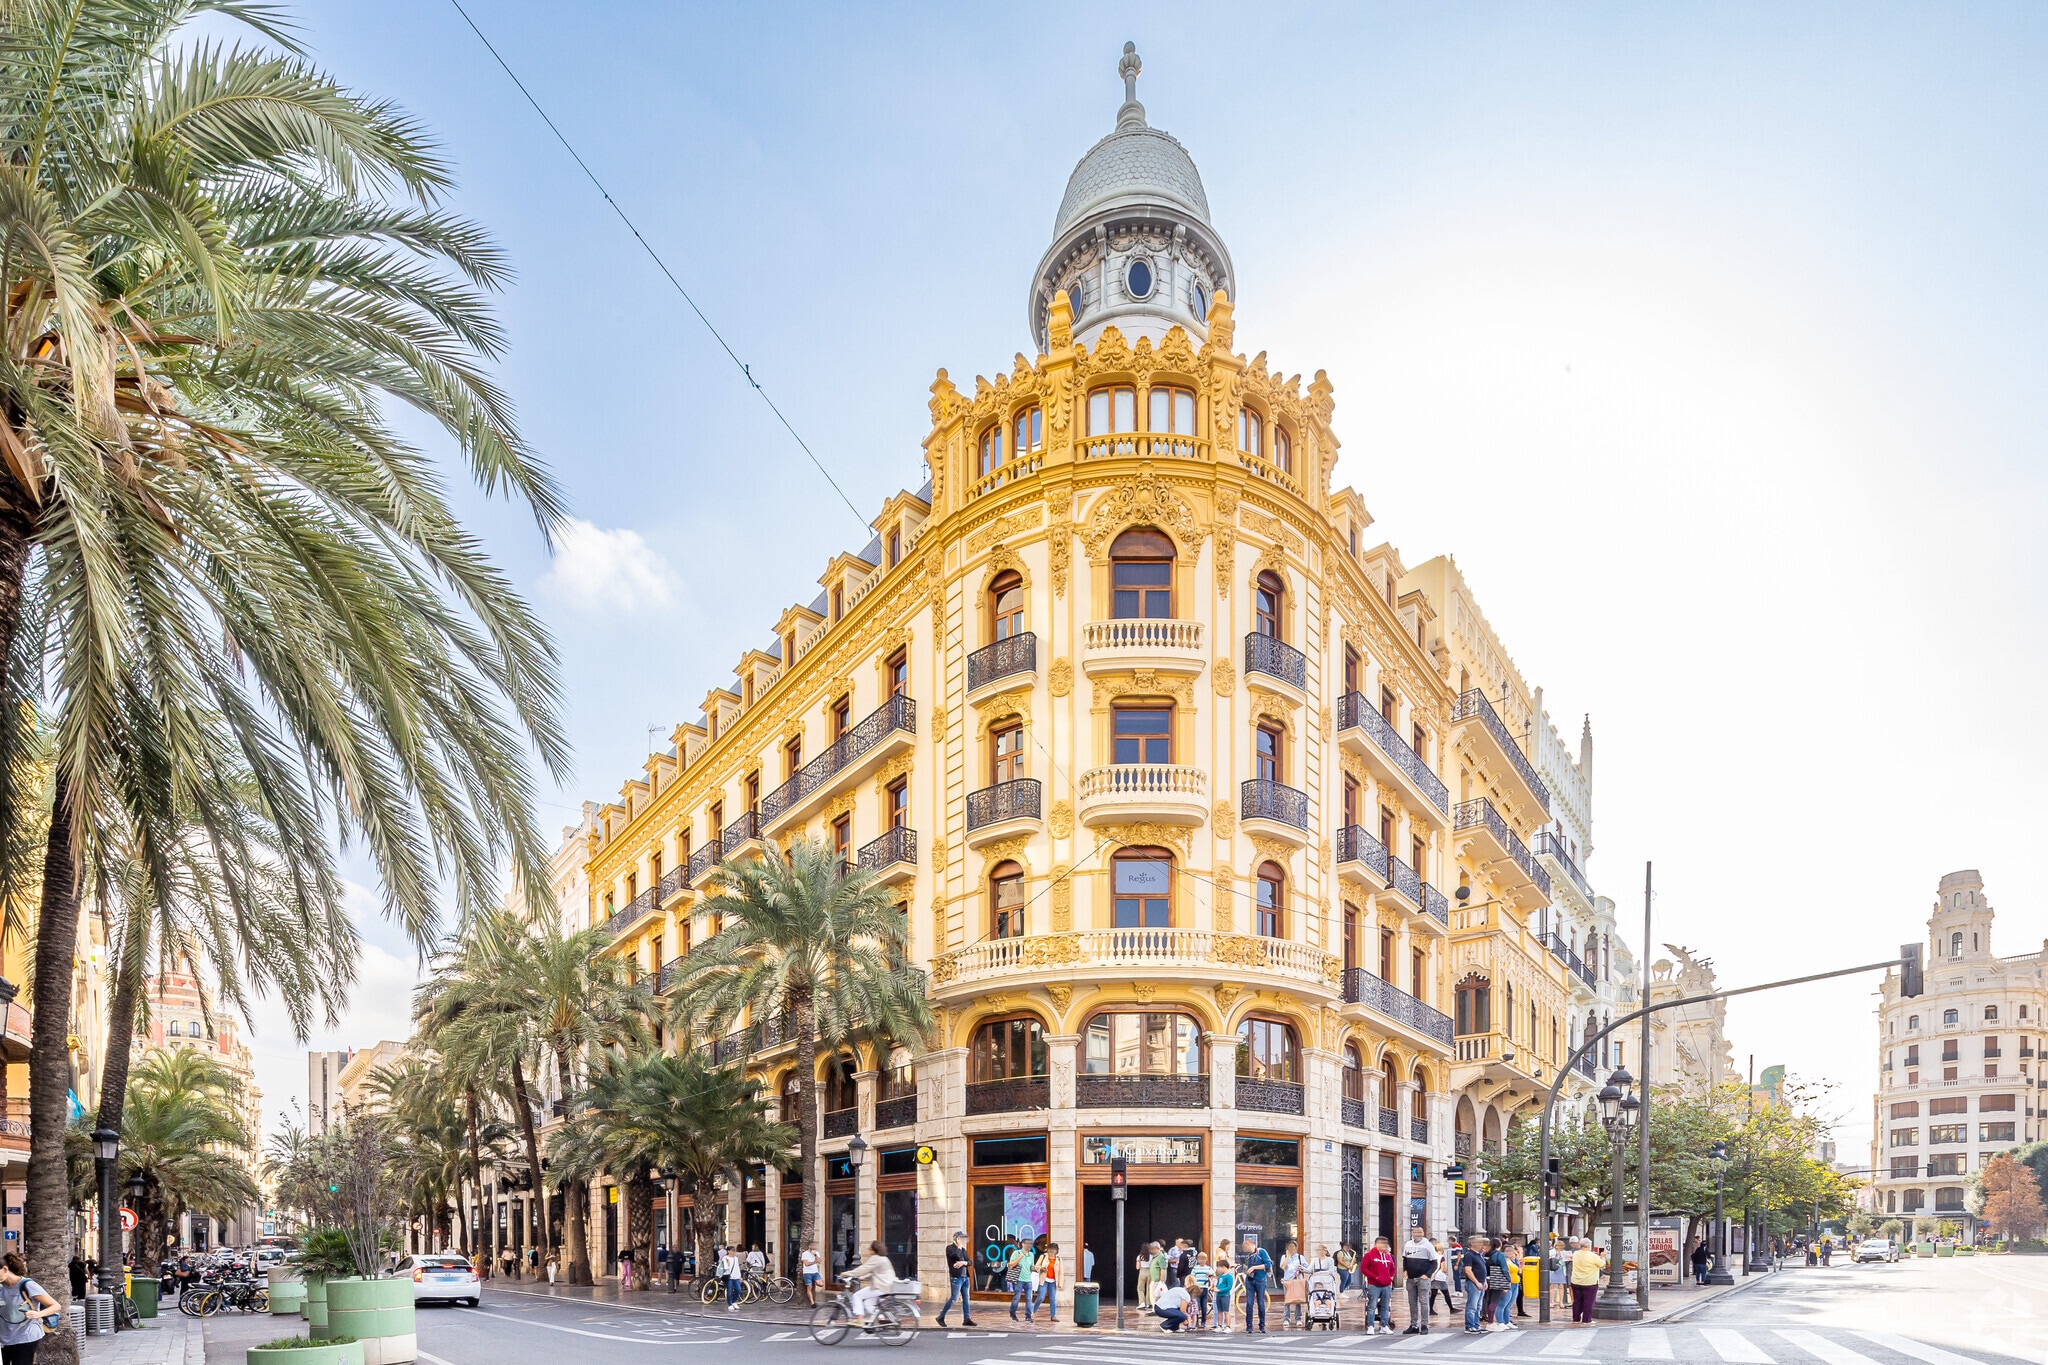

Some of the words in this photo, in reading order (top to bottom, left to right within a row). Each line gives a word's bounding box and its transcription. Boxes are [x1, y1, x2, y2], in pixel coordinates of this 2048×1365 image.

[1128, 874, 1156, 883] Regus
[1124, 1143, 1187, 1156] CaixaBank
[985, 1216, 1008, 1241] all
[1015, 1220, 1035, 1242] in
[985, 1244, 1037, 1262] on
